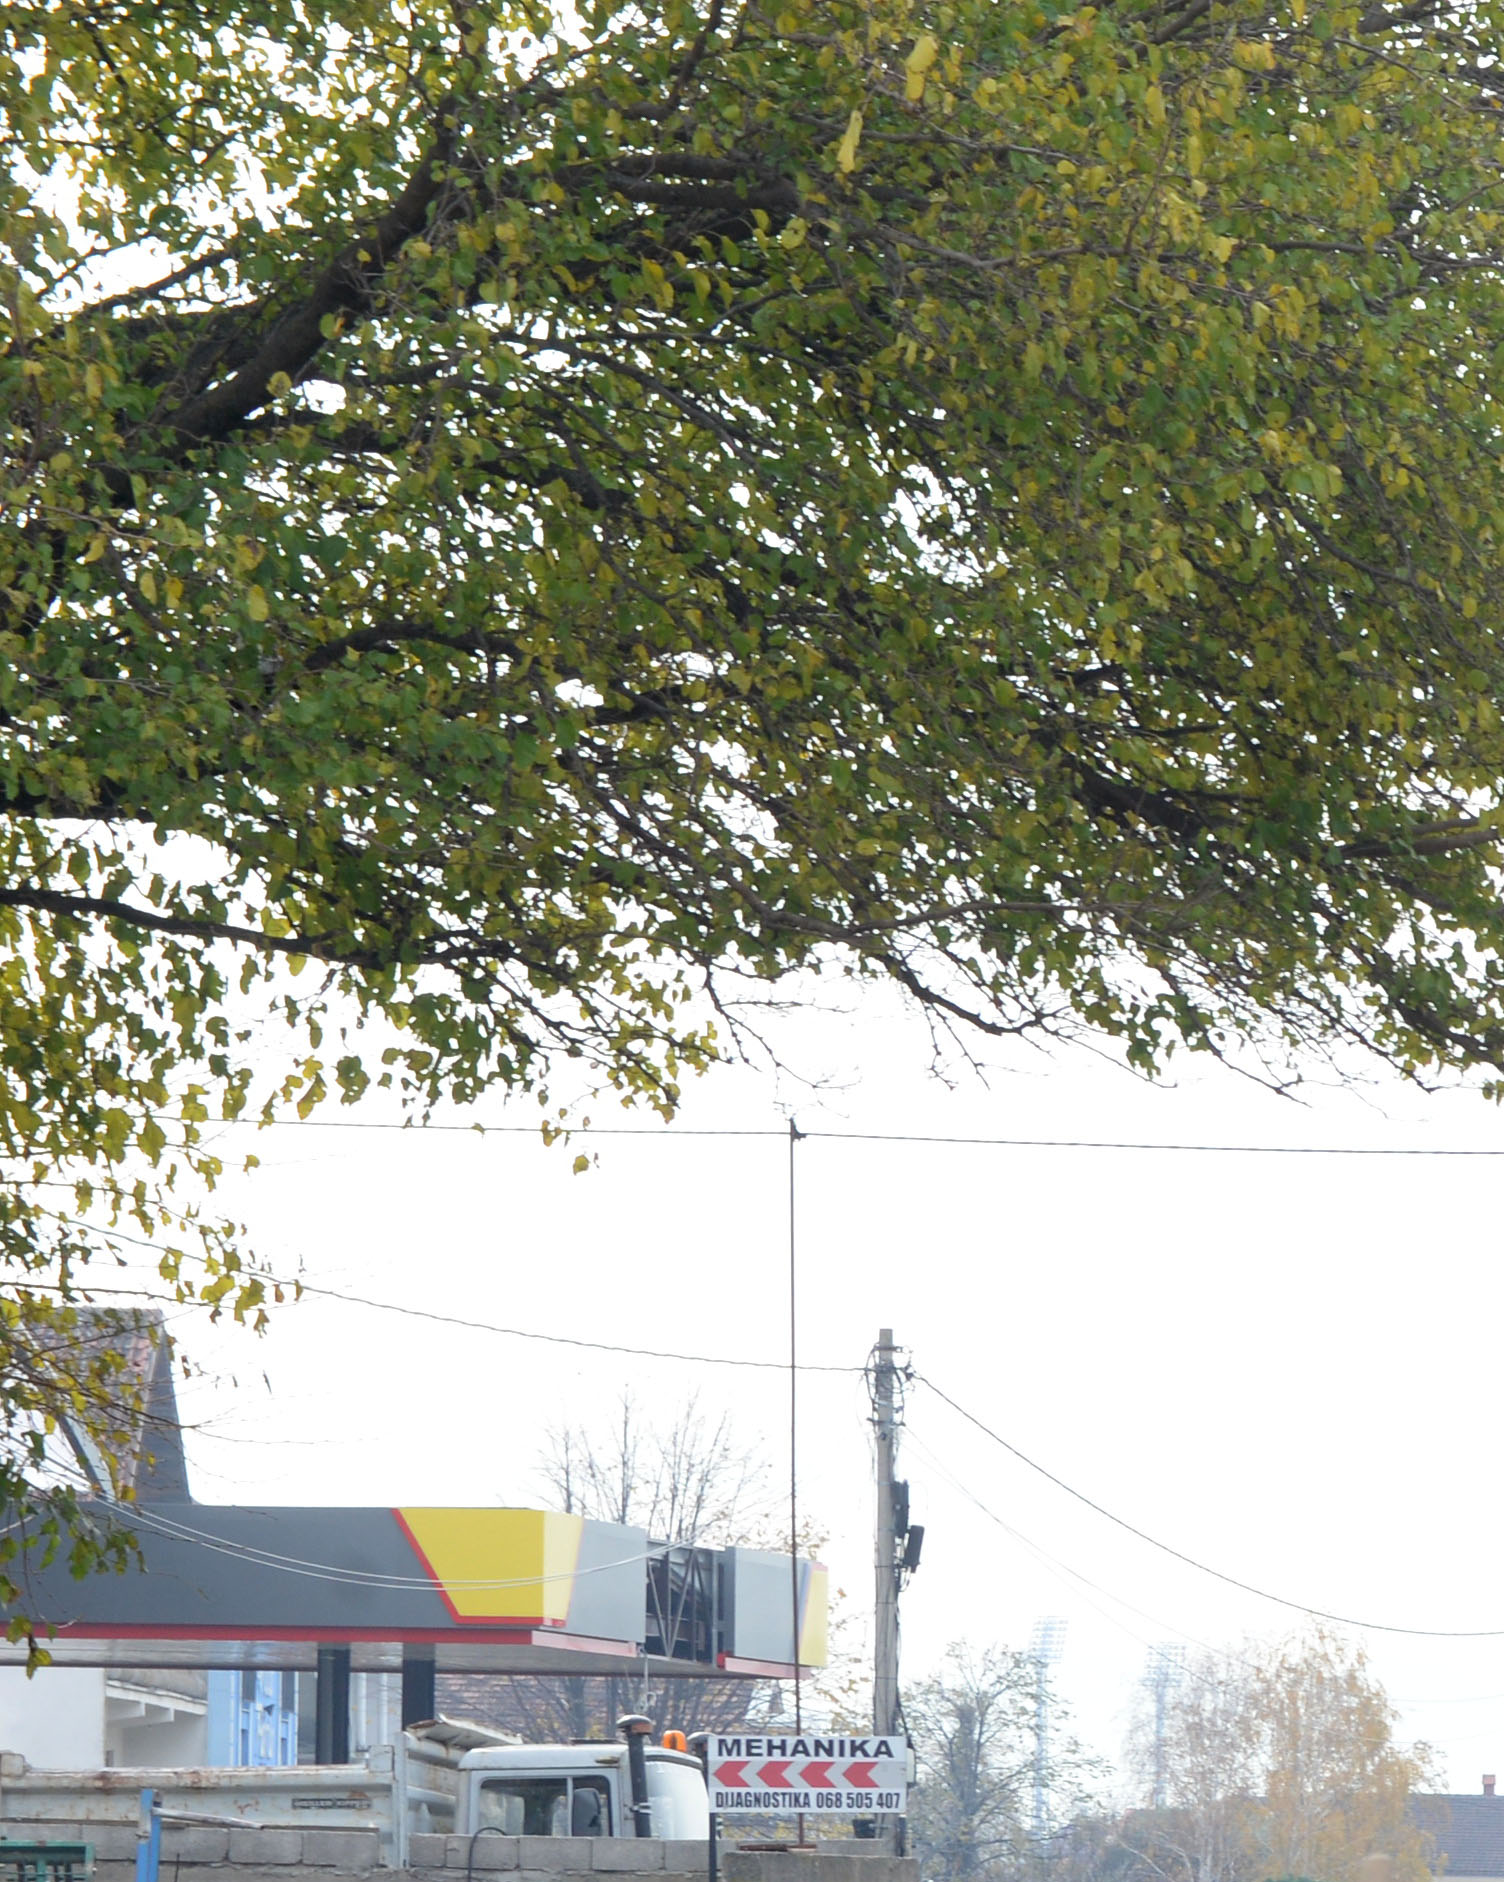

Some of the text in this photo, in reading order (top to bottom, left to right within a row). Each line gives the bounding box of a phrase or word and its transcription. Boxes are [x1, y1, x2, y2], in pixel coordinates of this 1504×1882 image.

[717, 1738, 895, 1759] MEHANIKA
[715, 1791, 901, 1809] DIJAGNOSTIKA 068 505 407
